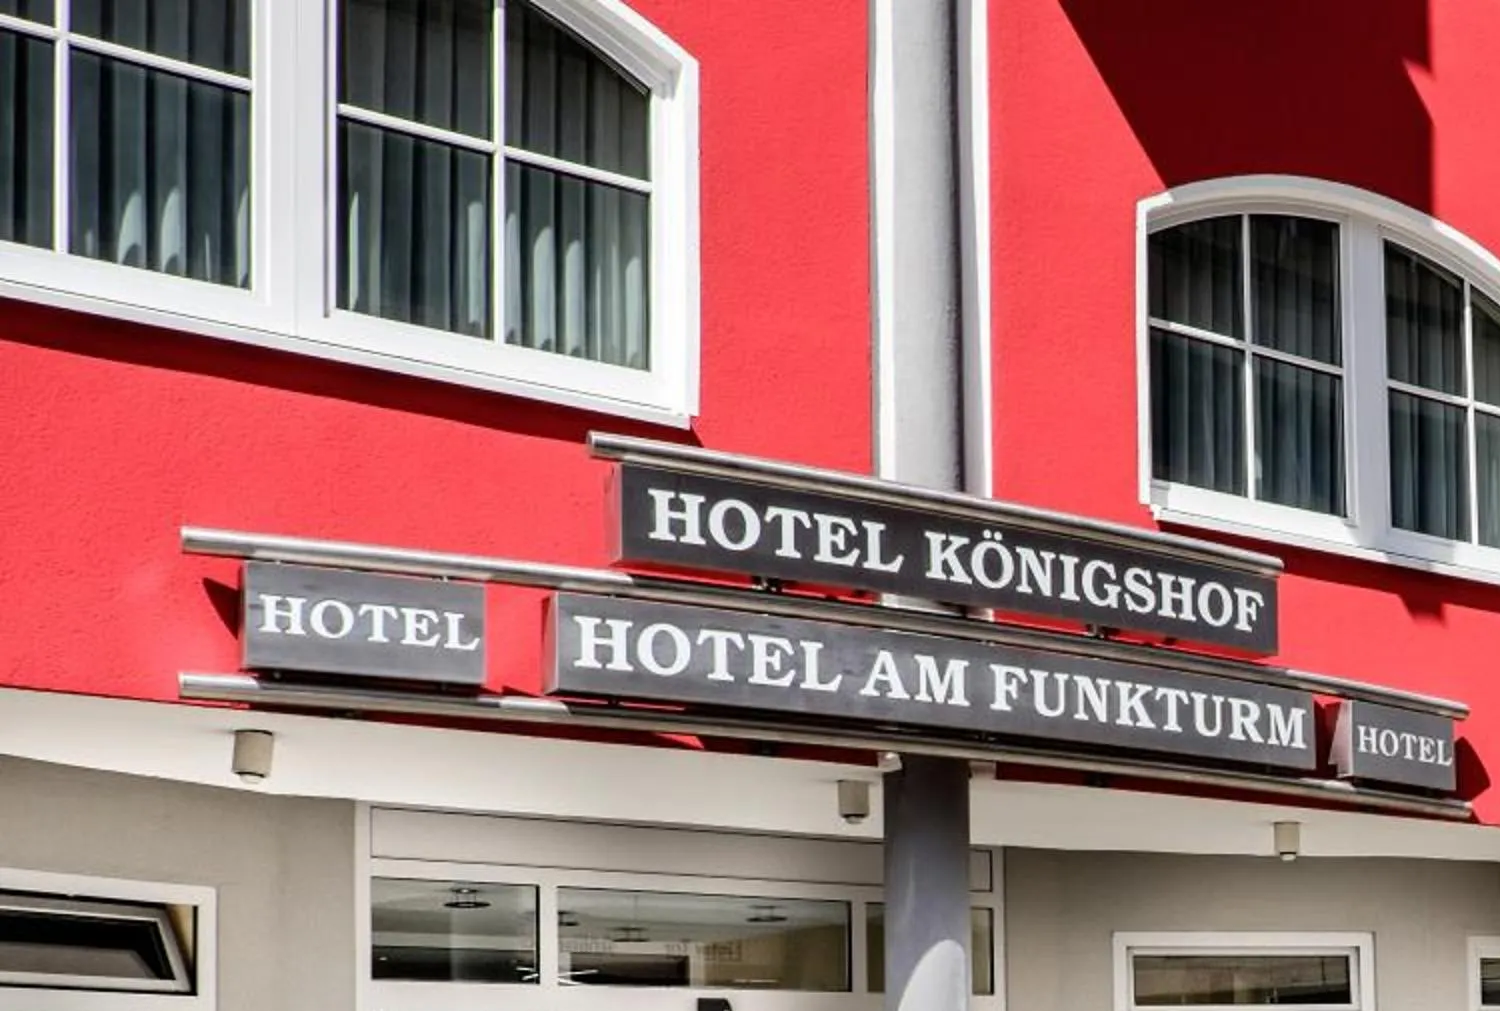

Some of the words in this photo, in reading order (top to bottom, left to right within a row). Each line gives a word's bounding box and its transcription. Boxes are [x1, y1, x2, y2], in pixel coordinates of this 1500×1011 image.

[647, 488, 903, 573] HOTEL
[923, 529, 1265, 634] KÖNIGSHOF
[258, 593, 481, 653] HOTEL
[573, 615, 842, 693] HOTEL
[859, 649, 970, 708] AM
[988, 663, 1308, 750] FUNKTURM
[1357, 725, 1453, 767] HOTEL
